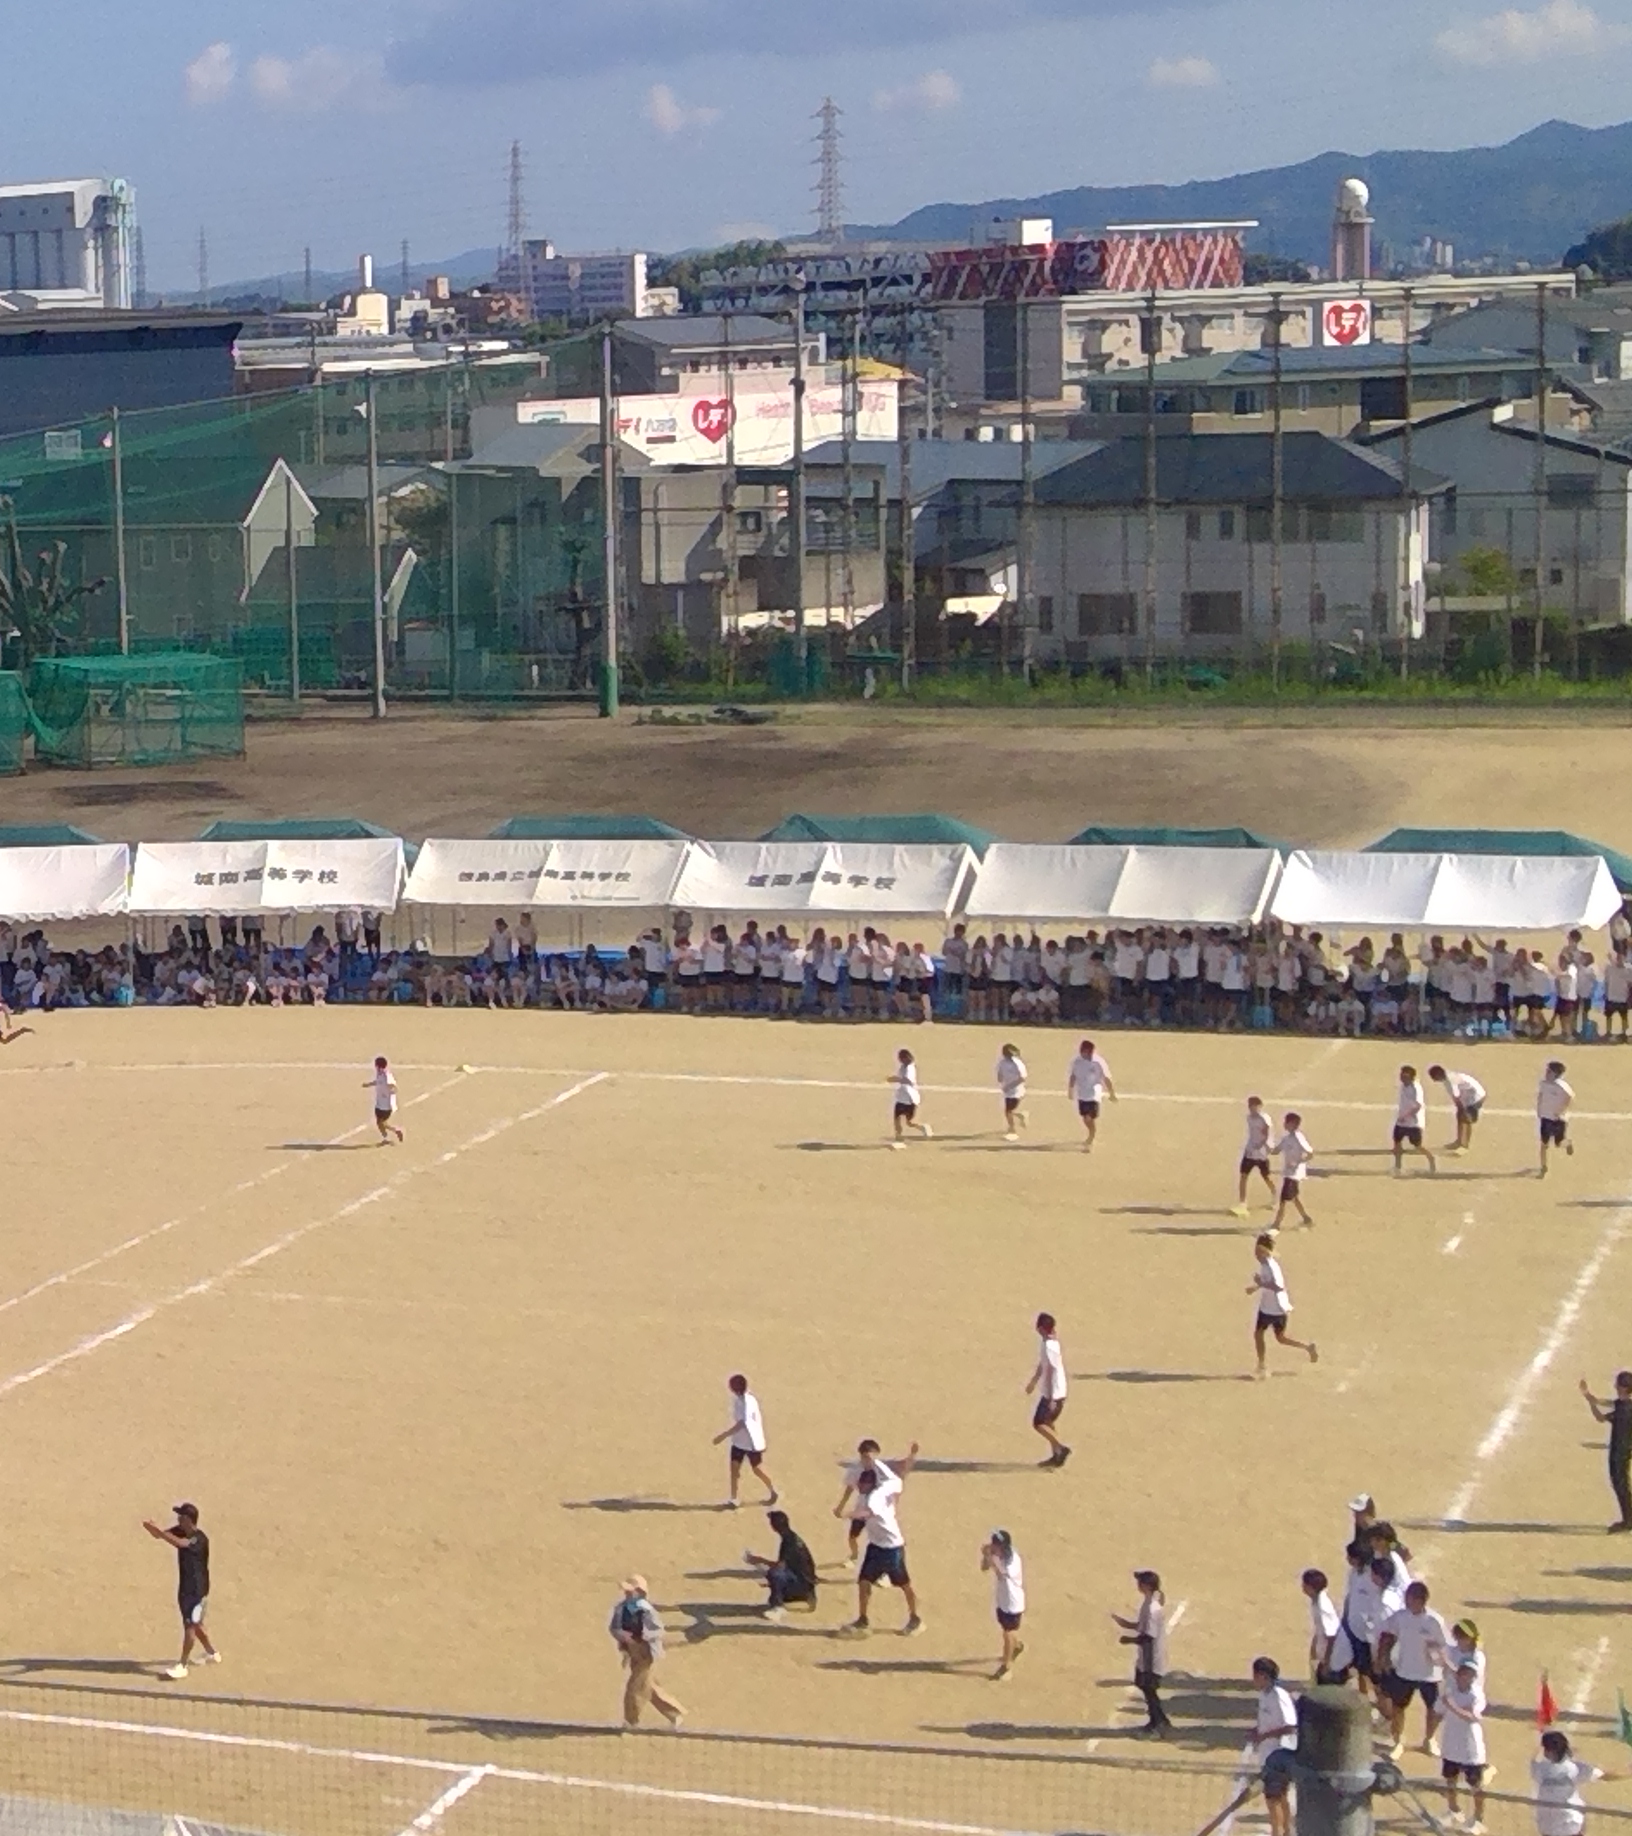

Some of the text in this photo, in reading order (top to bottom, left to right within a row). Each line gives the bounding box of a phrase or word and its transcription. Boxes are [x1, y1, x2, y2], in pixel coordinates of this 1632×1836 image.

[1328, 312, 1366, 336] レディ
[194, 867, 339, 886] 城南高等学校
